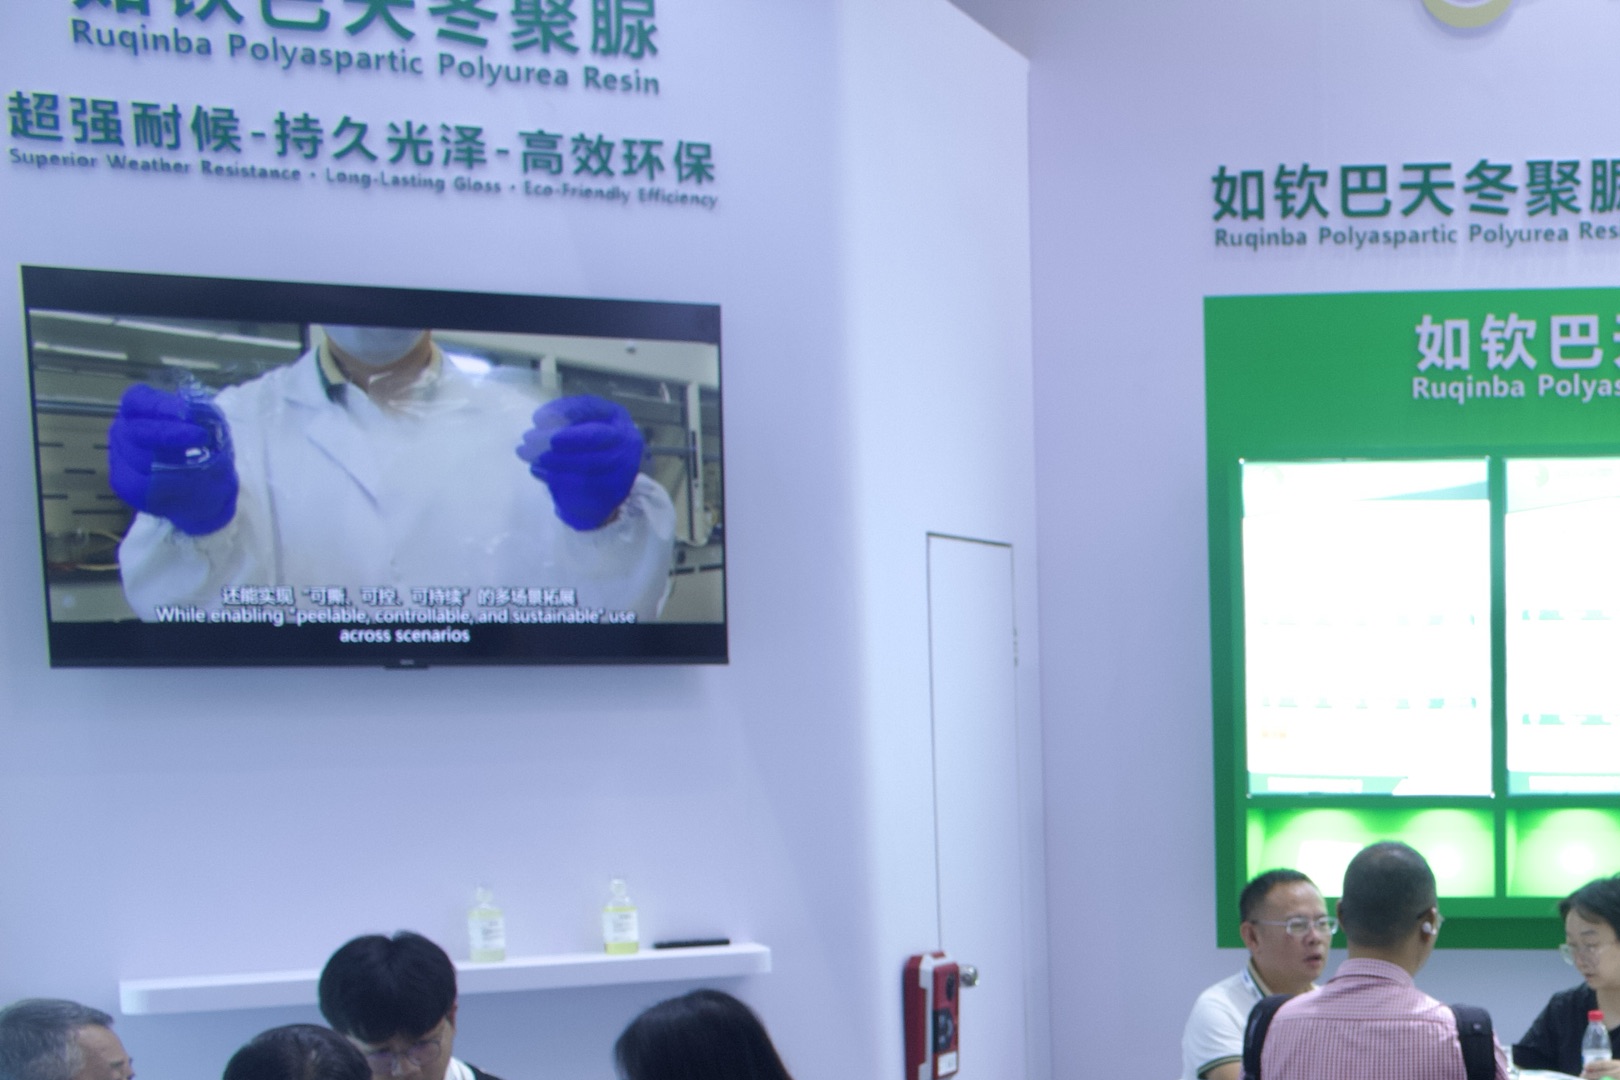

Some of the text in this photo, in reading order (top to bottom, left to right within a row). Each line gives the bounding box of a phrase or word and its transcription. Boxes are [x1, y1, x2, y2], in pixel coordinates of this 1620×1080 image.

[71, 18, 660, 95] Ruqinba Polyaspartic Polyurea Resin
[7, 90, 716, 186] 超强耐候-持久光泽-高效环保
[10, 148, 718, 209] Superior Weather Resistance Long-Lasting Gloss Eco-Friendly Efficiency
[1214, 226, 1307, 251] Ruqinba
[1319, 224, 1457, 249] Polyaspartic
[1469, 222, 1569, 248] Polyurea
[1413, 376, 1525, 403] Ruqinba
[156, 606, 206, 623] While
[211, 607, 284, 627] enabling
[375, 608, 474, 626] controllable,
[478, 608, 508, 623] and
[609, 611, 636, 624] use
[339, 626, 471, 643] across scenarios
